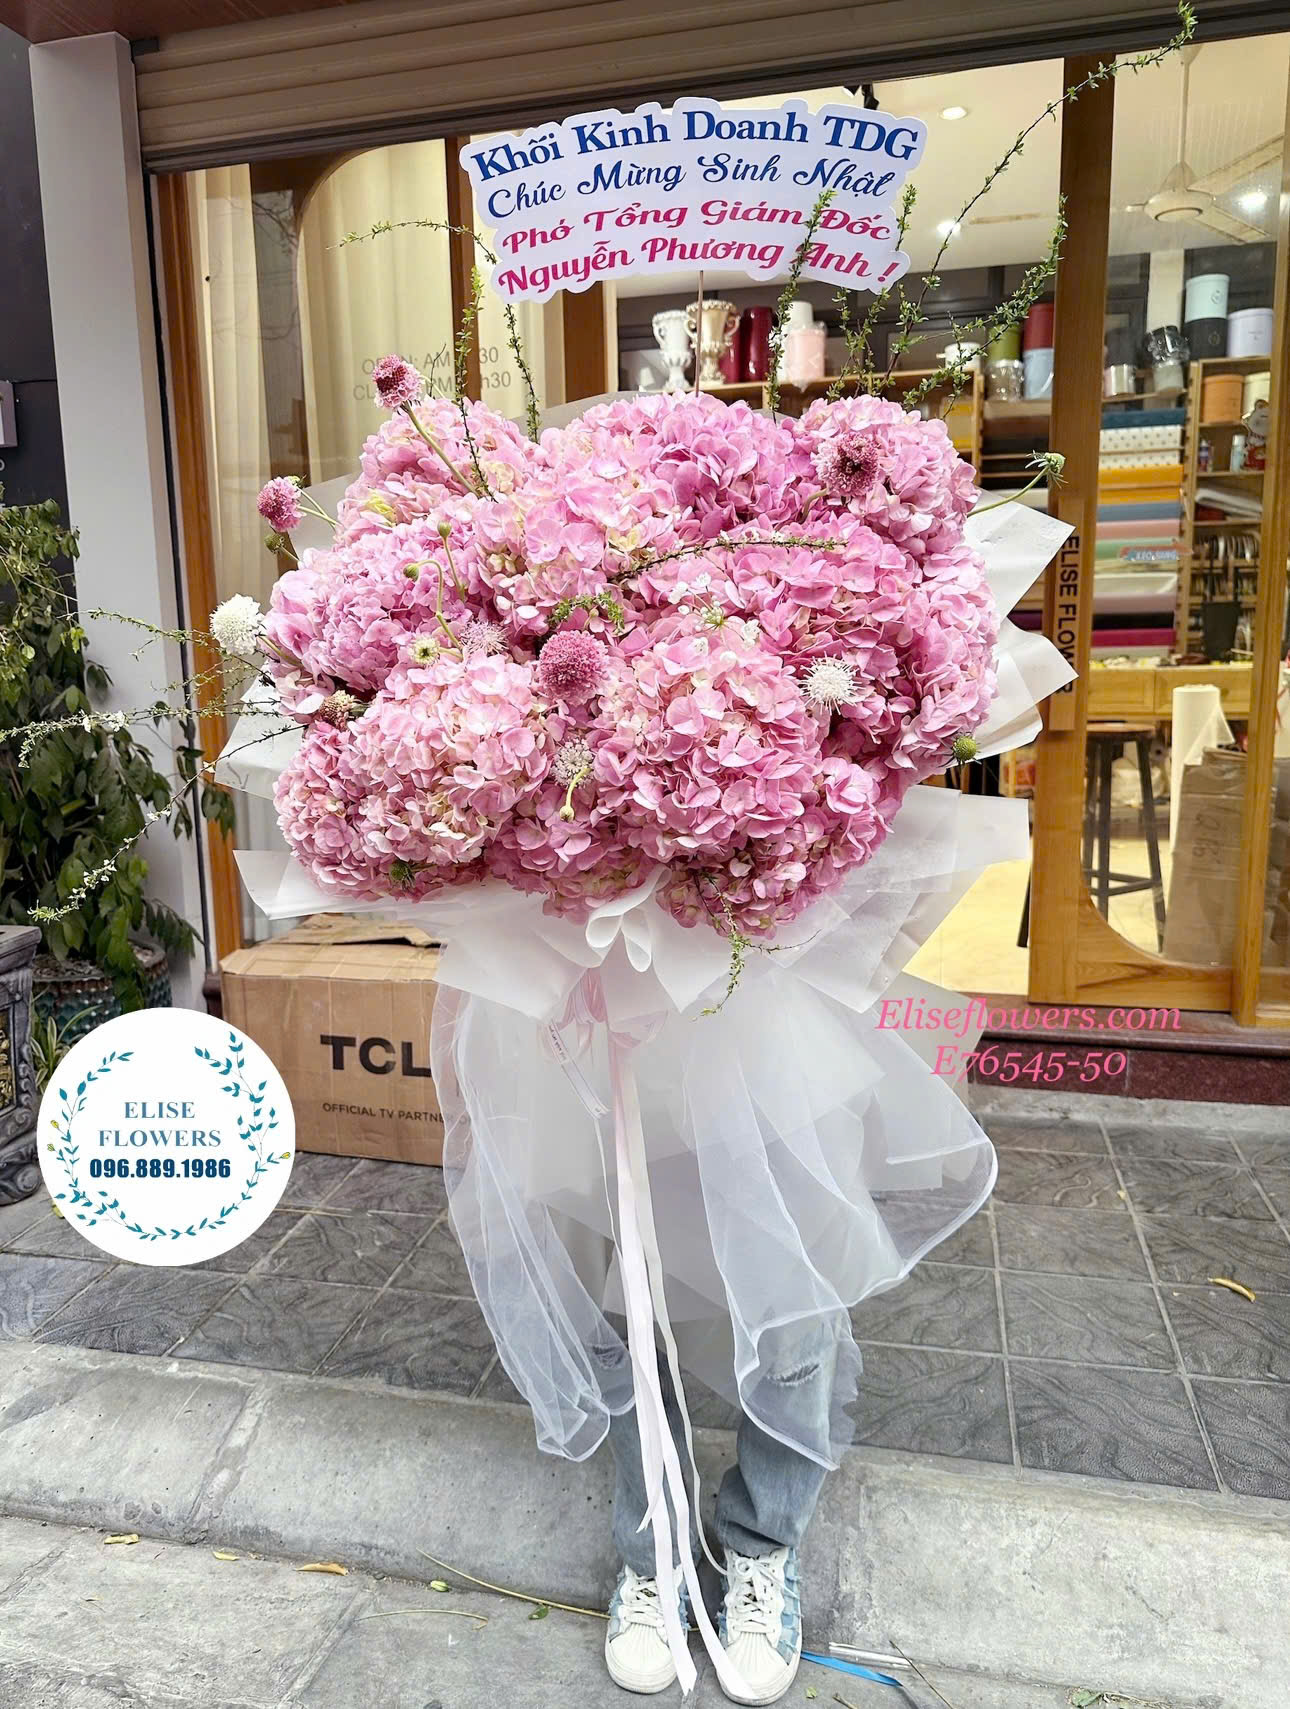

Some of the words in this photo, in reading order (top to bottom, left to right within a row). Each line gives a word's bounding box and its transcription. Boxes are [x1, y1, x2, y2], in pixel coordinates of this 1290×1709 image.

[472, 133, 563, 182] Khối
[572, 114, 669, 154] Kinh
[683, 110, 809, 144] Doanh
[823, 115, 918, 161] TDG
[488, 180, 565, 218] Chúc
[577, 159, 686, 195] Mừng
[697, 152, 781, 183] Sinh
[792, 158, 894, 197] Nhật
[503, 216, 574, 255] Phó
[584, 202, 688, 230] Tổng
[701, 200, 803, 225] Giám
[817, 208, 892, 241] Đốc
[498, 240, 634, 295] Nguyễn
[641, 236, 783, 269] Phương
[793, 242, 881, 277] Anh
[878, 263, 899, 282] !
[423, 351, 450, 369] AM
[1060, 535, 1079, 597] ELISE
[320, 1034, 432, 1078] TCL
[322, 1102, 377, 1117] OFFICIAL
[380, 1108, 394, 1119] TV
